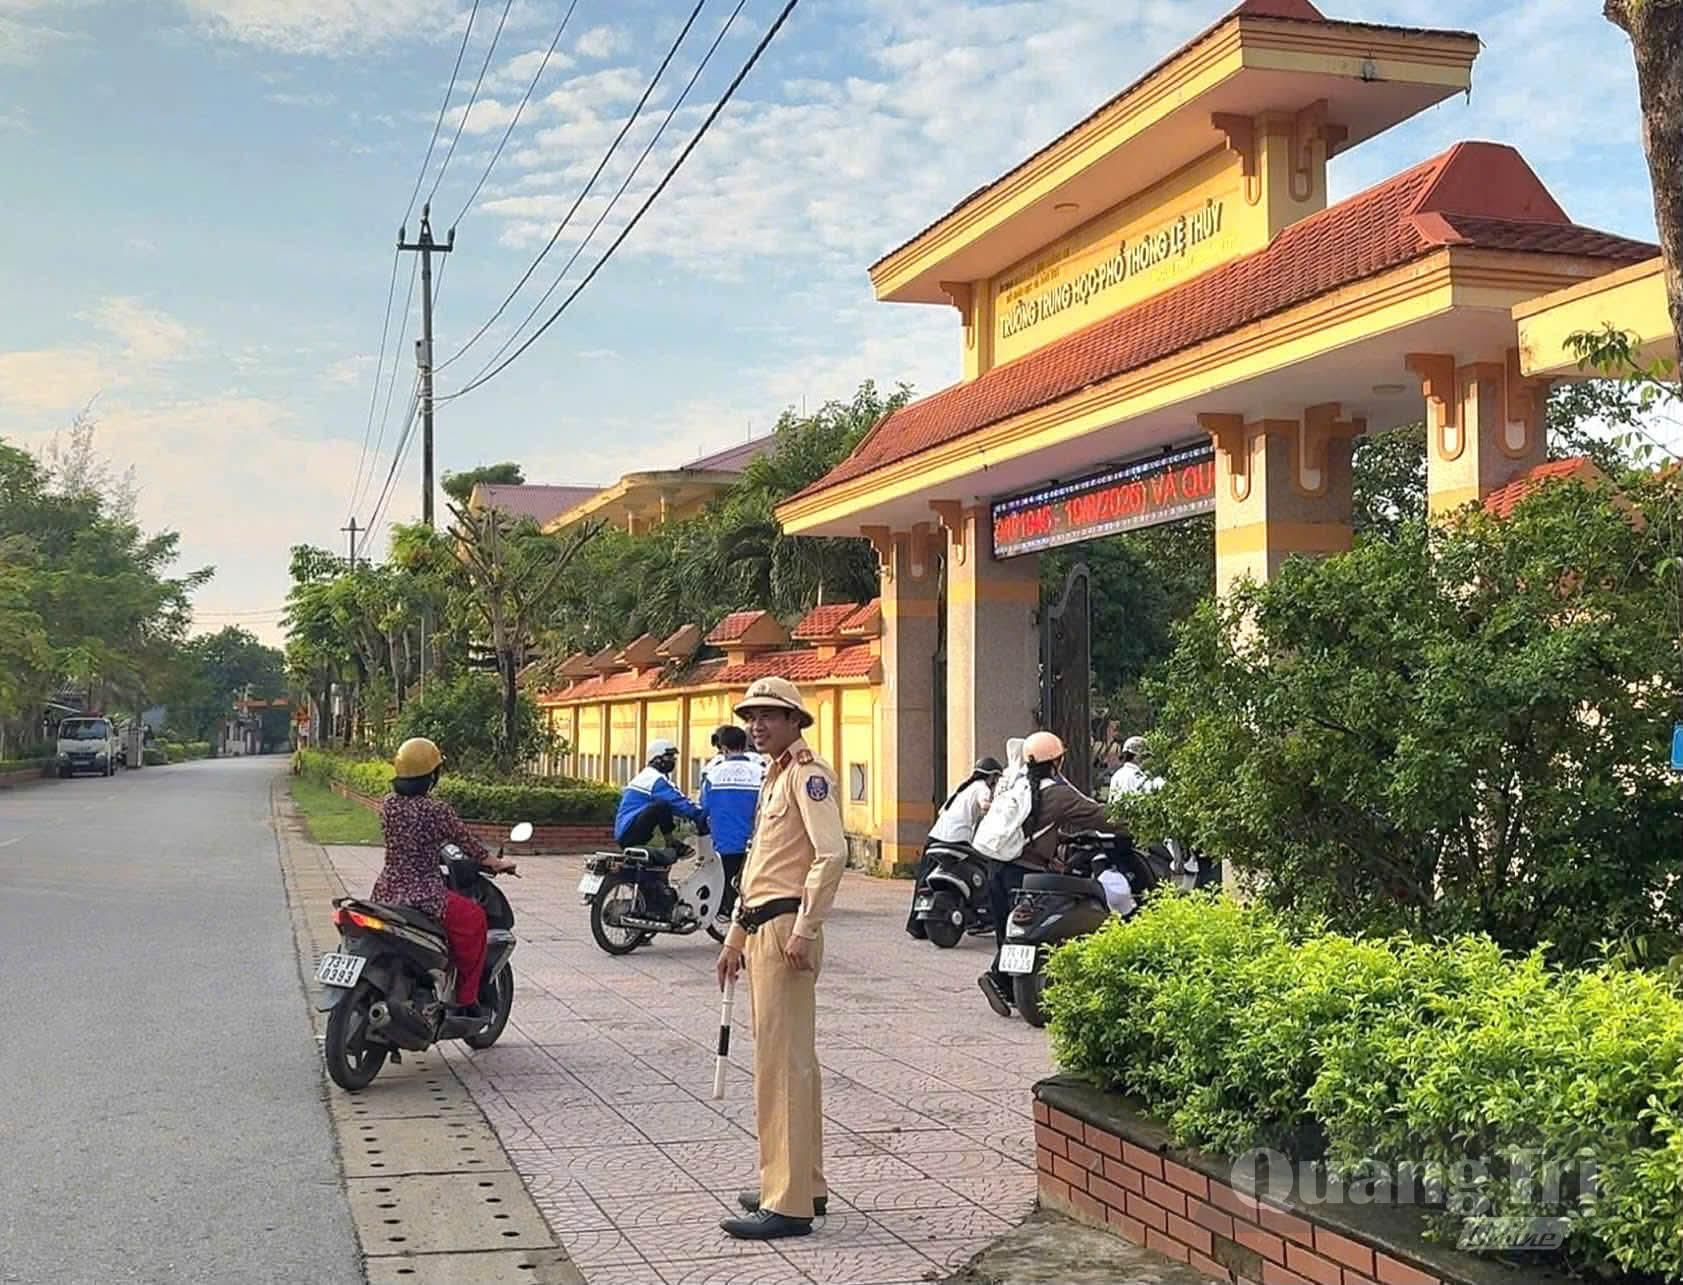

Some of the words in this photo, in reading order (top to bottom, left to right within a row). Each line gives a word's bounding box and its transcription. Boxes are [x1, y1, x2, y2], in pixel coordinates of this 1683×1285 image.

[1001, 298, 1039, 338] TRƯỜNG
[1040, 282, 1074, 321] TRUNG
[1100, 239, 1127, 288] PHỔ
[1126, 234, 1171, 275] THÔNG
[1171, 215, 1187, 257] LỆ
[1182, 460, 1216, 497] QU
